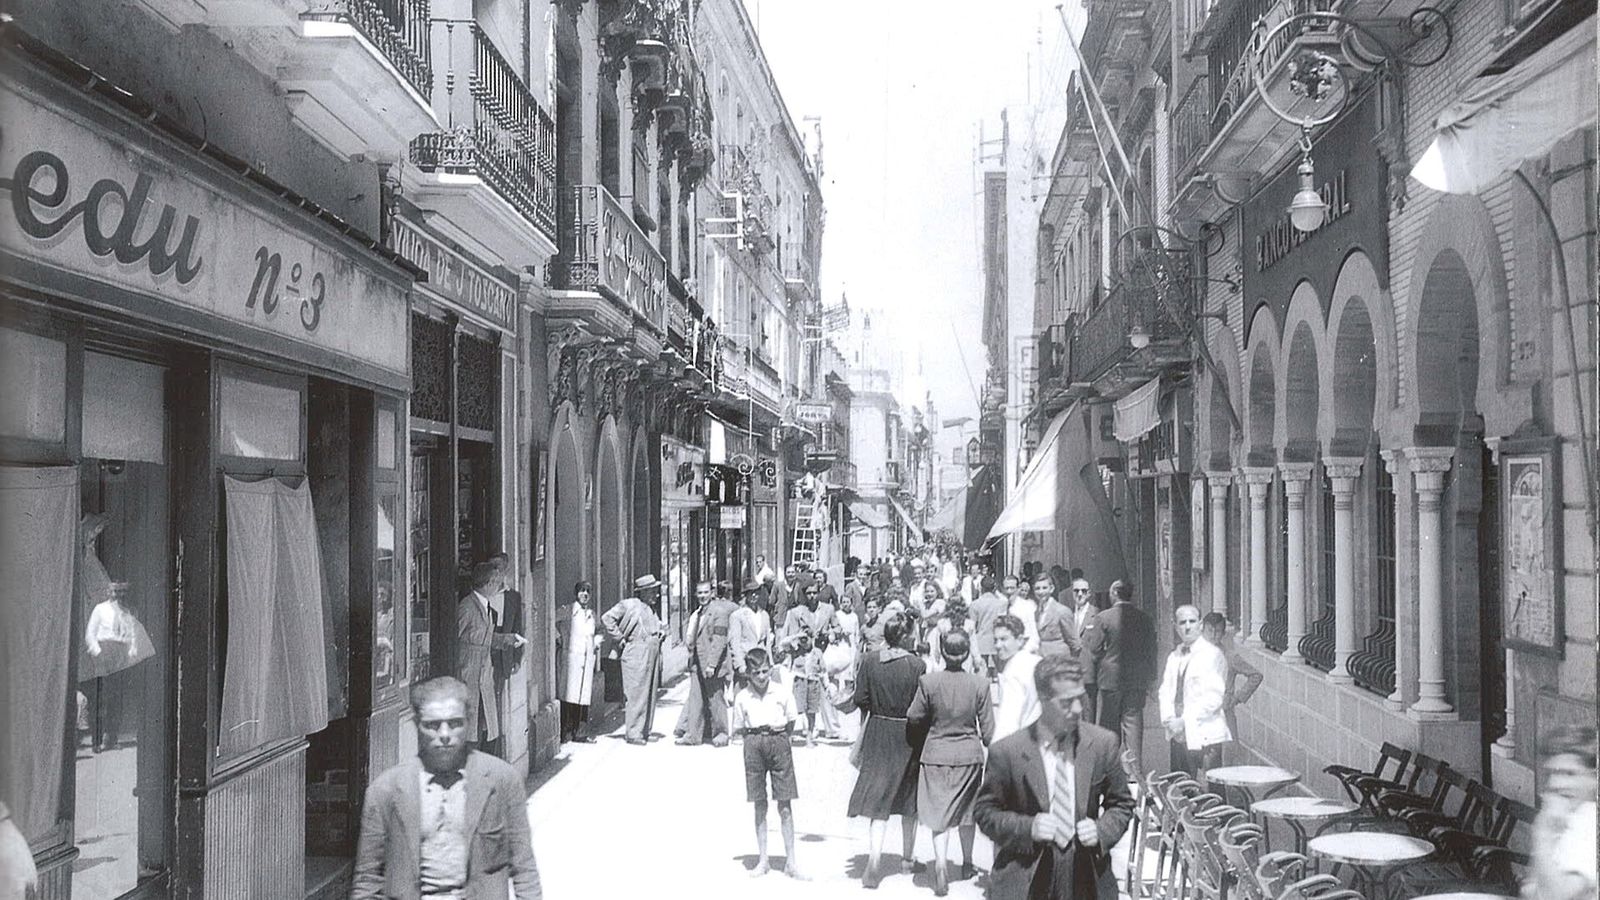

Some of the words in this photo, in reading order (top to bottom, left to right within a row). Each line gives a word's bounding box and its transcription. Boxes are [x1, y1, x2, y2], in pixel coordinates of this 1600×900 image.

[0, 150, 202, 285] edu
[1291, 170, 1351, 248] CRAL
[436, 248, 453, 292] DE
[468, 269, 514, 325] TOSCANO
